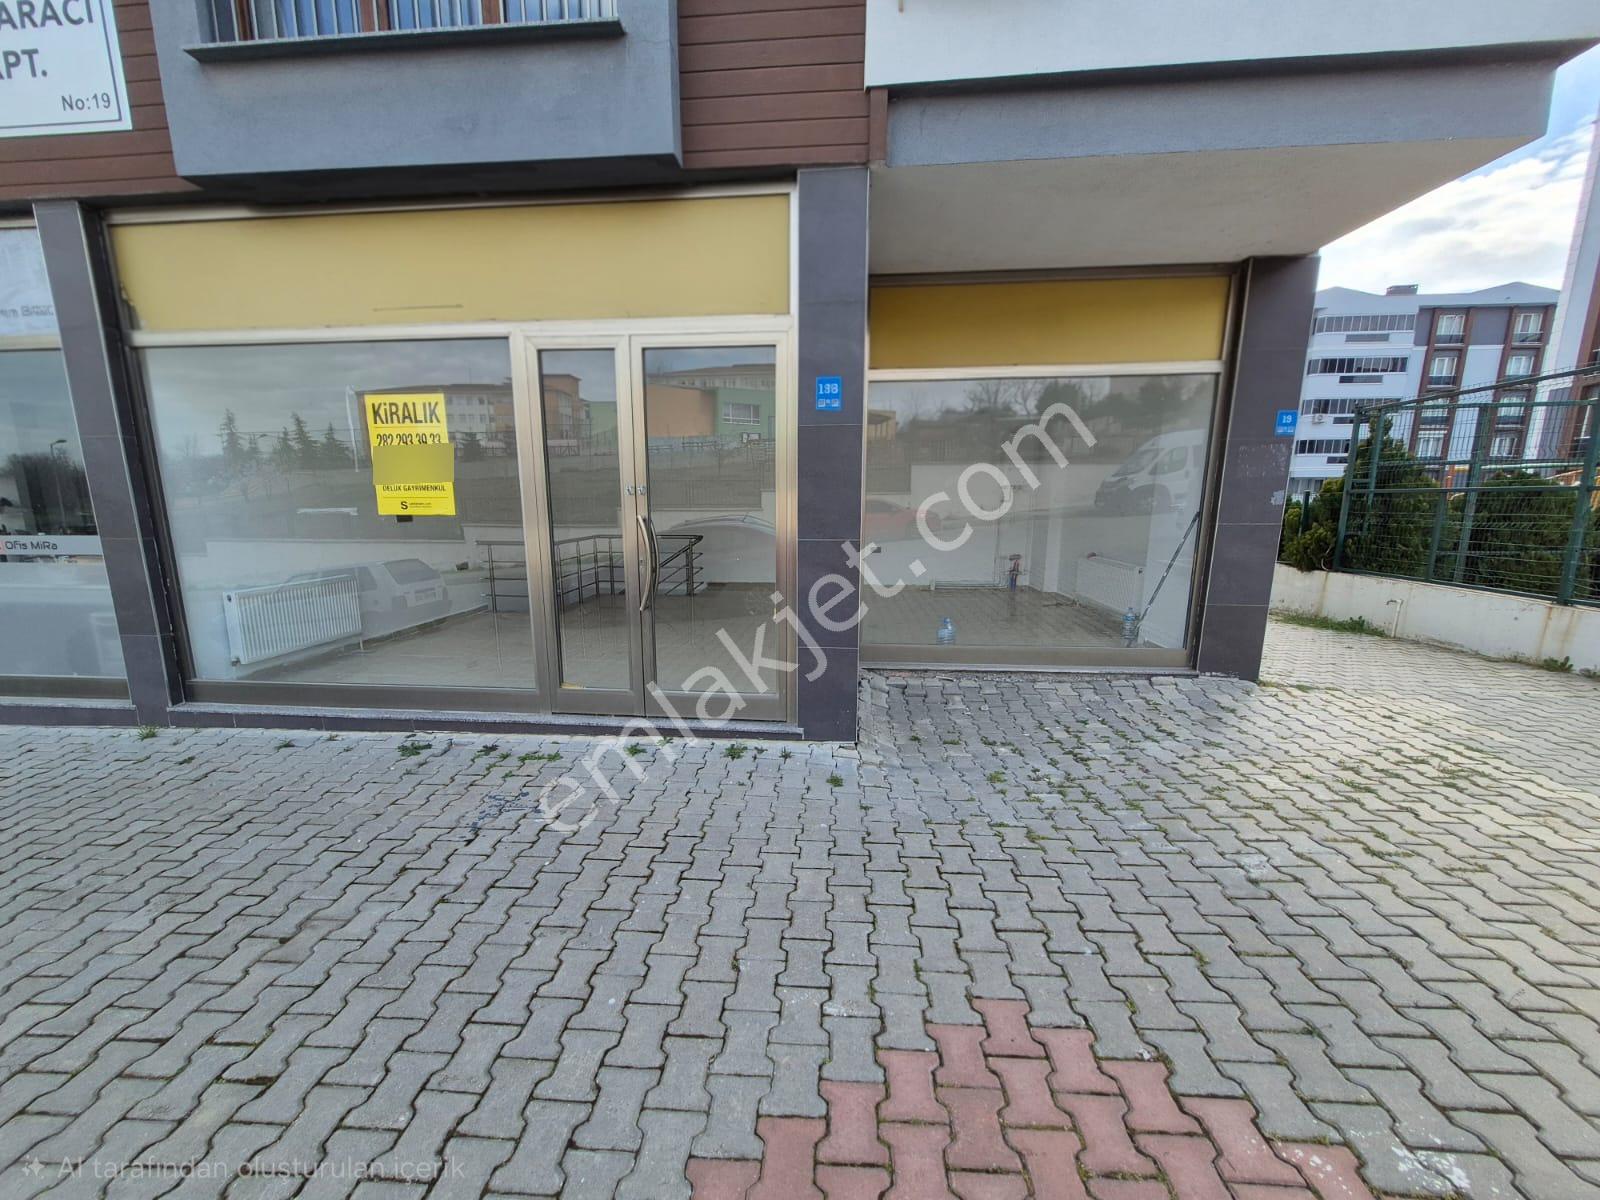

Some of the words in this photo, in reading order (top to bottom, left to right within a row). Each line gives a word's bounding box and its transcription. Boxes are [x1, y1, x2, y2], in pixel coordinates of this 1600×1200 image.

[0, 48, 48, 80] PT.
[61, 92, 111, 111] No:19
[1282, 414, 1292, 424] 19
